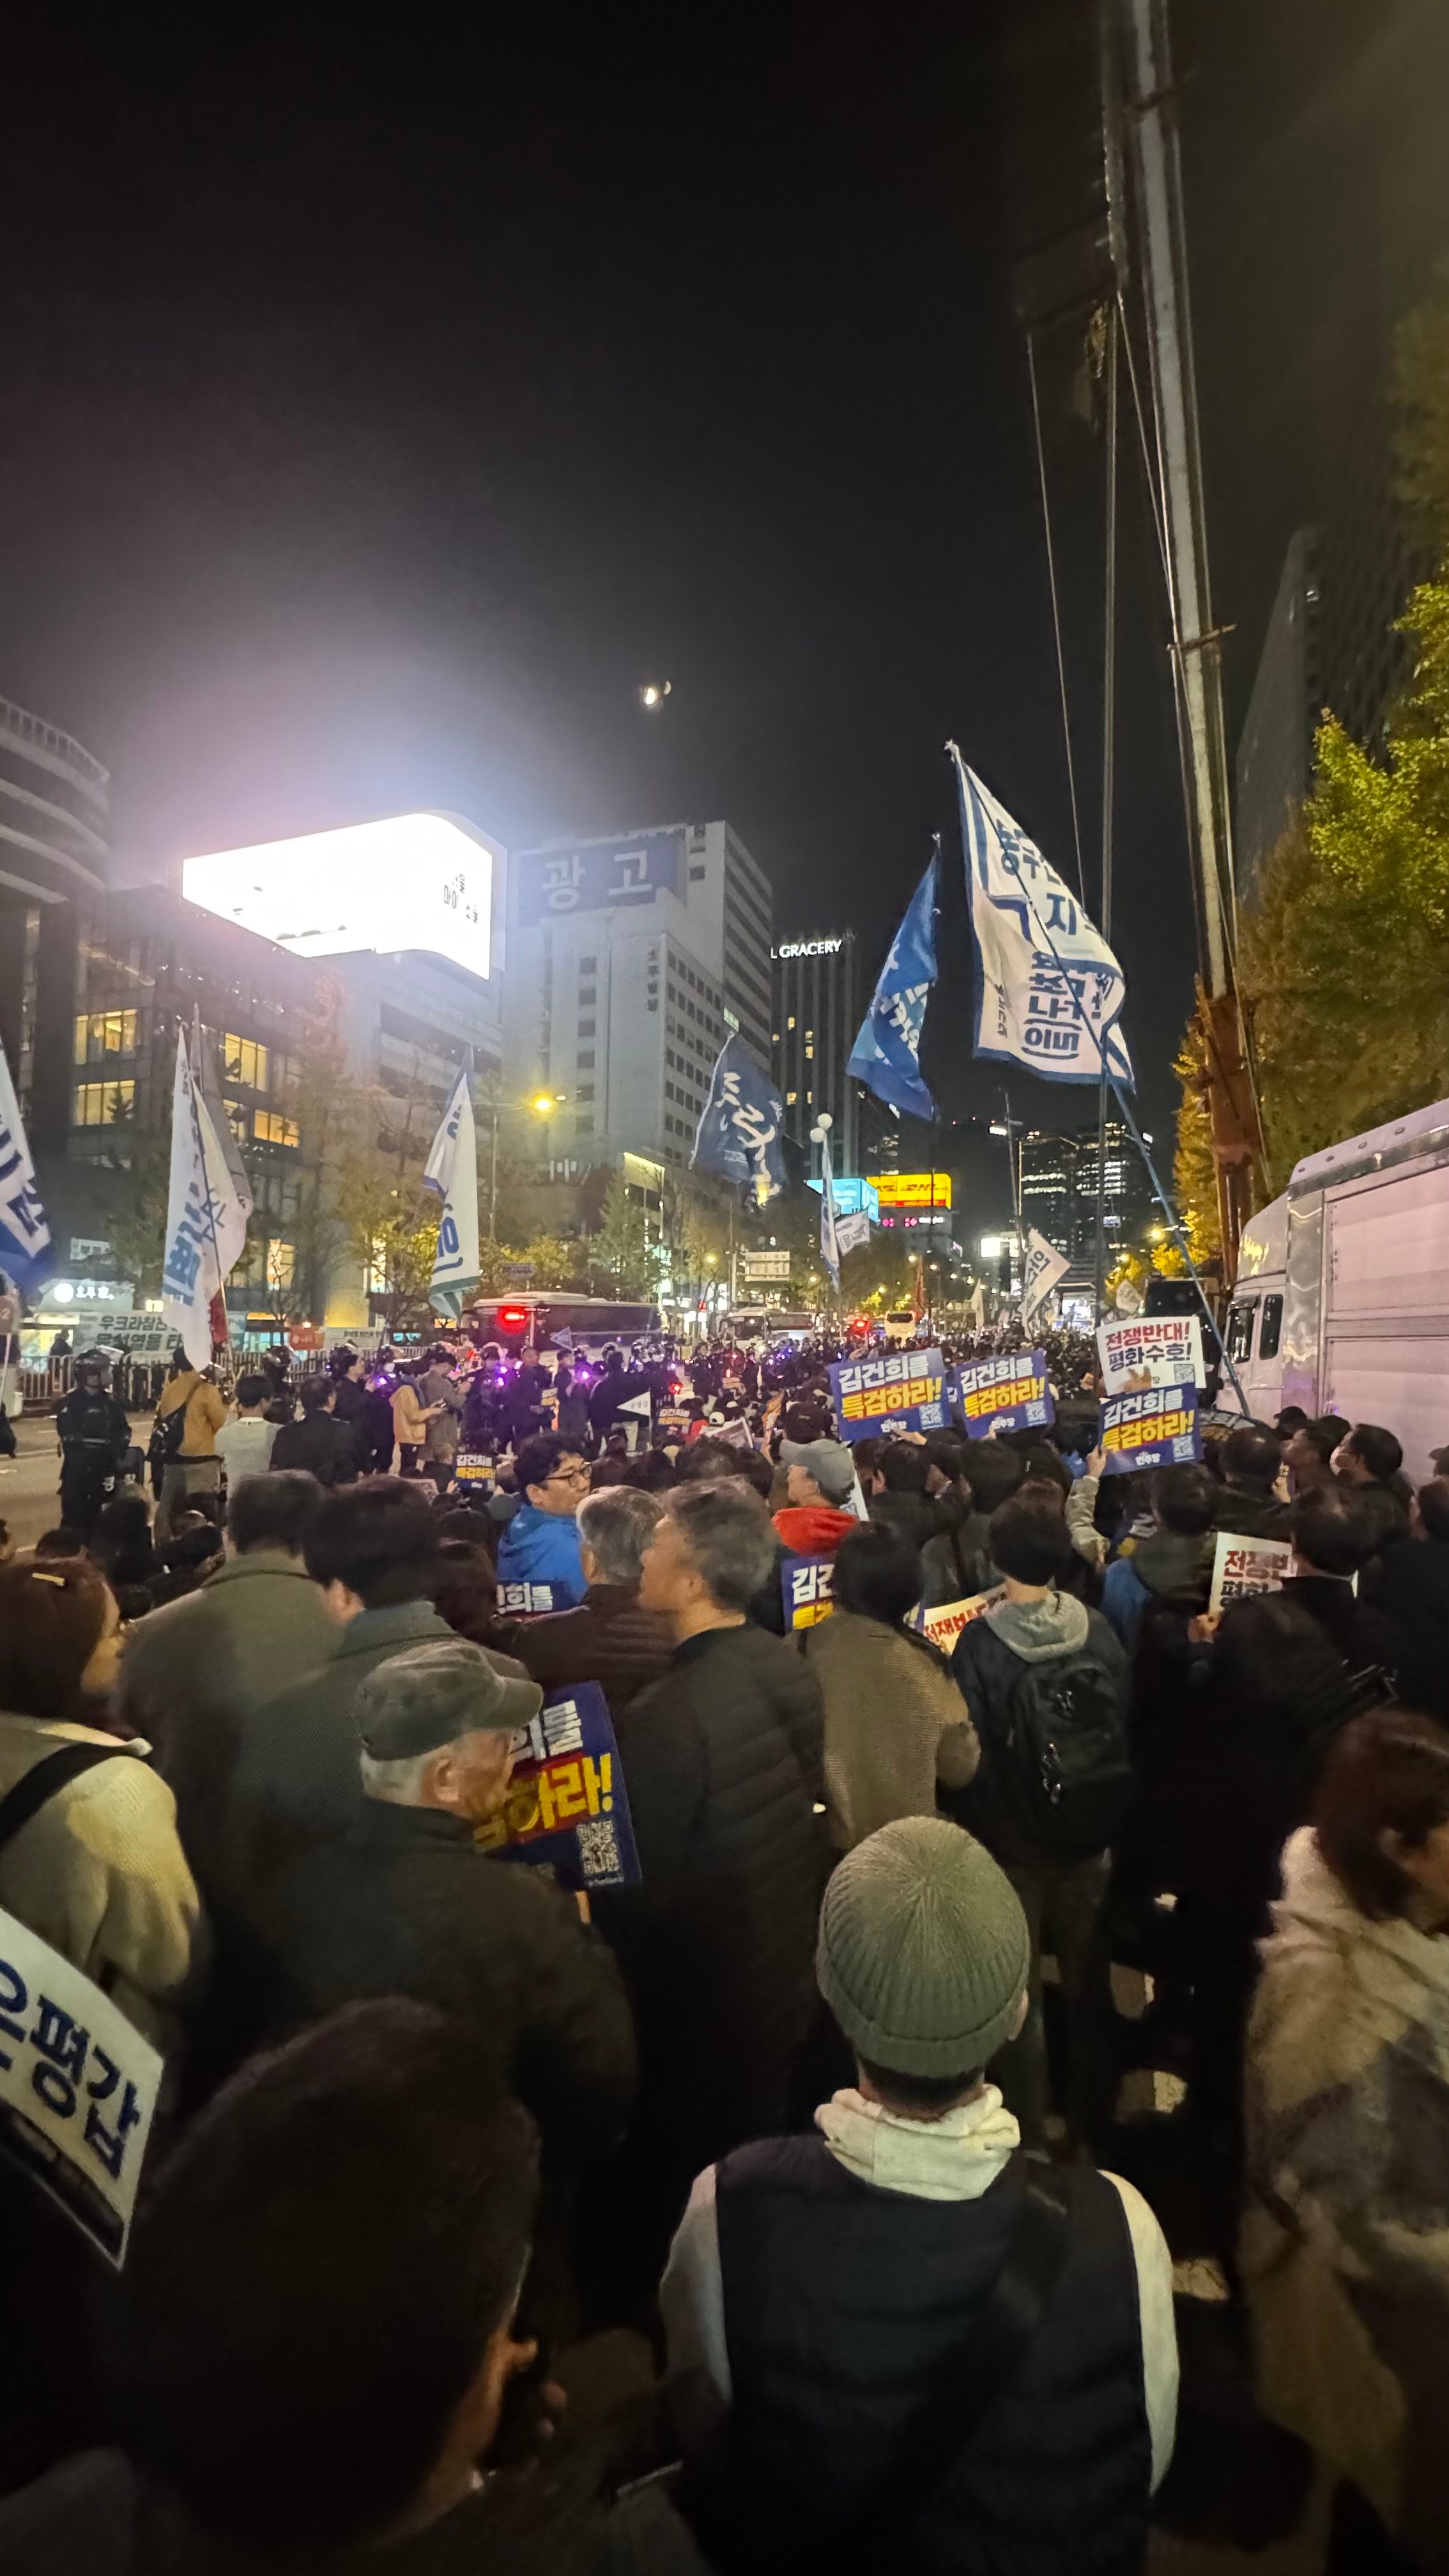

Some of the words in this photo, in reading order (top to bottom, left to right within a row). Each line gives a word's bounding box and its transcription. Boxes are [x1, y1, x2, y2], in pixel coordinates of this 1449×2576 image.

[542, 850, 653, 910] 광고
[778, 939, 843, 958] GRACERY
[1105, 1321, 1190, 1353] 전쟁반대!
[838, 1354, 928, 1394] 김건희를
[960, 1356, 1034, 1395] 김건희를
[1108, 1342, 1192, 1373] 평화수호!
[840, 1376, 942, 1419] 특검하라!
[963, 1376, 1045, 1418] 특검하라!
[1103, 1388, 1183, 1430] 김건희를
[1101, 1409, 1195, 1452] 특검하라!
[1134, 1451, 1161, 1466] 민주당
